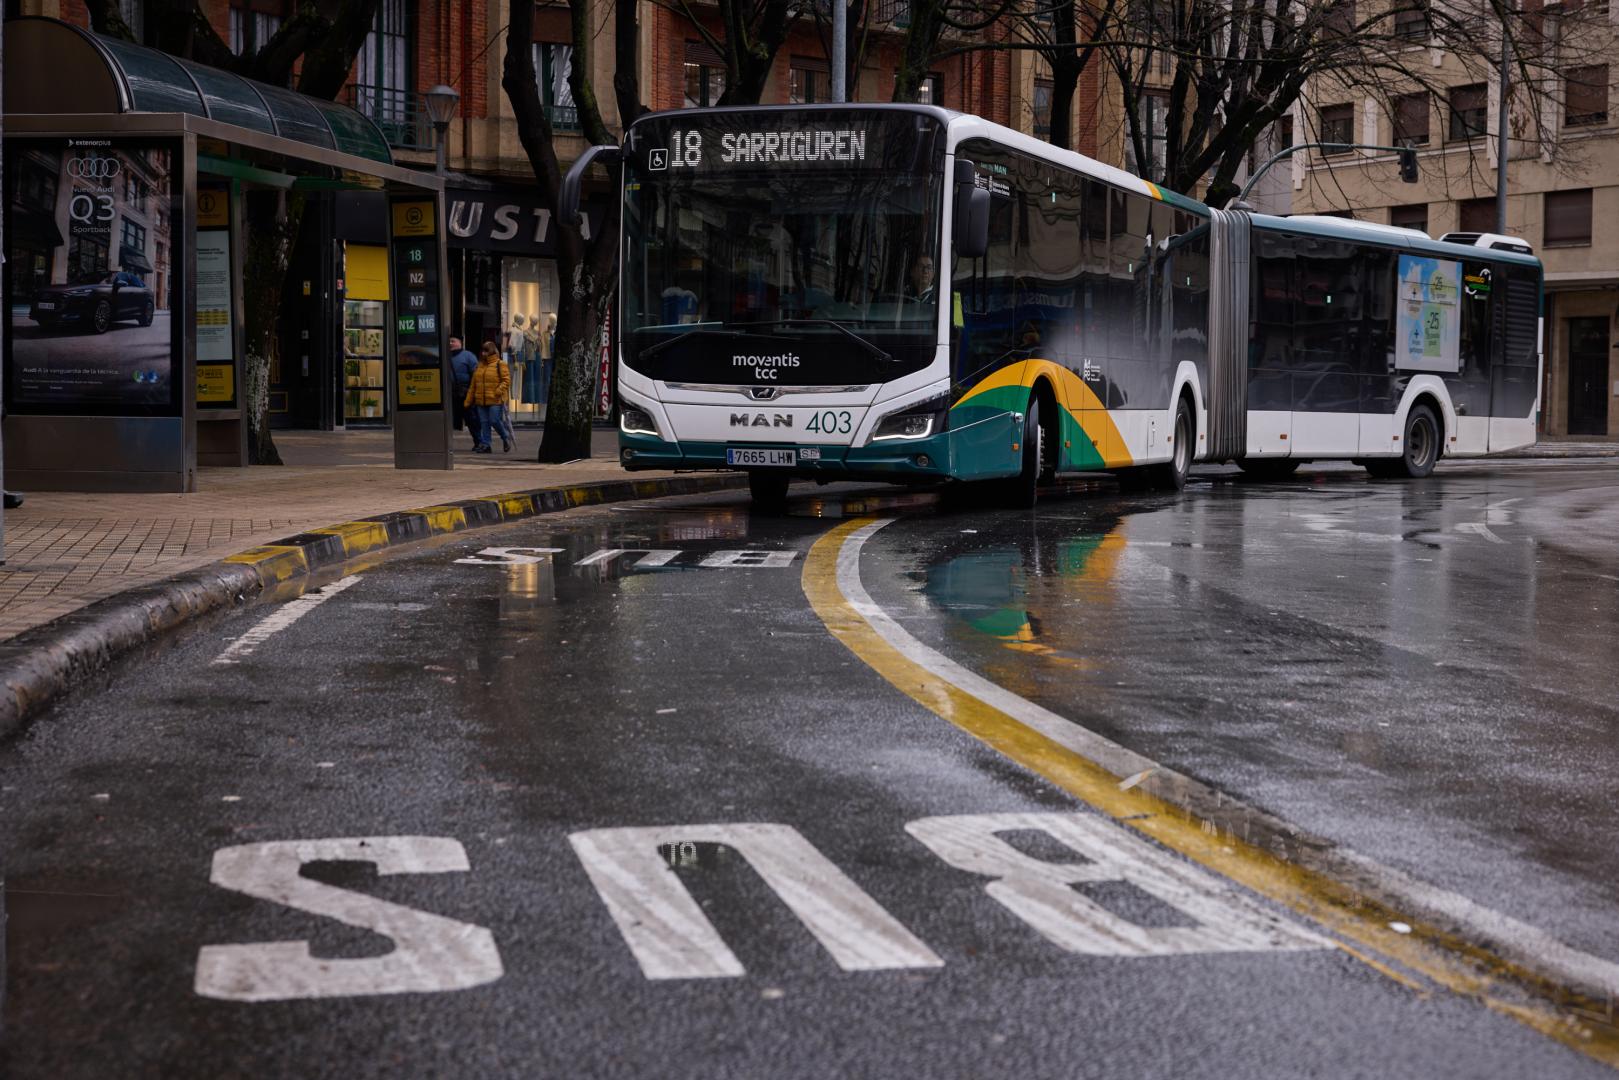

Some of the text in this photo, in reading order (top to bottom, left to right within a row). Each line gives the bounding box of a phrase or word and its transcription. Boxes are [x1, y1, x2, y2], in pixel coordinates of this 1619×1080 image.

[672, 130, 866, 167] 18 SARRIGUREN
[97, 185, 115, 193] Audi
[69, 194, 116, 225] Q3
[73, 225, 113, 234] Sportback
[409, 249, 422, 262] 18
[409, 272, 424, 284] N2
[410, 295, 425, 307] N7
[398, 317, 435, 331] N12 N16
[732, 352, 800, 367] moventis
[755, 367, 778, 379] tcc
[730, 411, 852, 434] MAN 403
[735, 451, 793, 464] 7665 LHW
[194, 810, 1340, 1003] BUS
